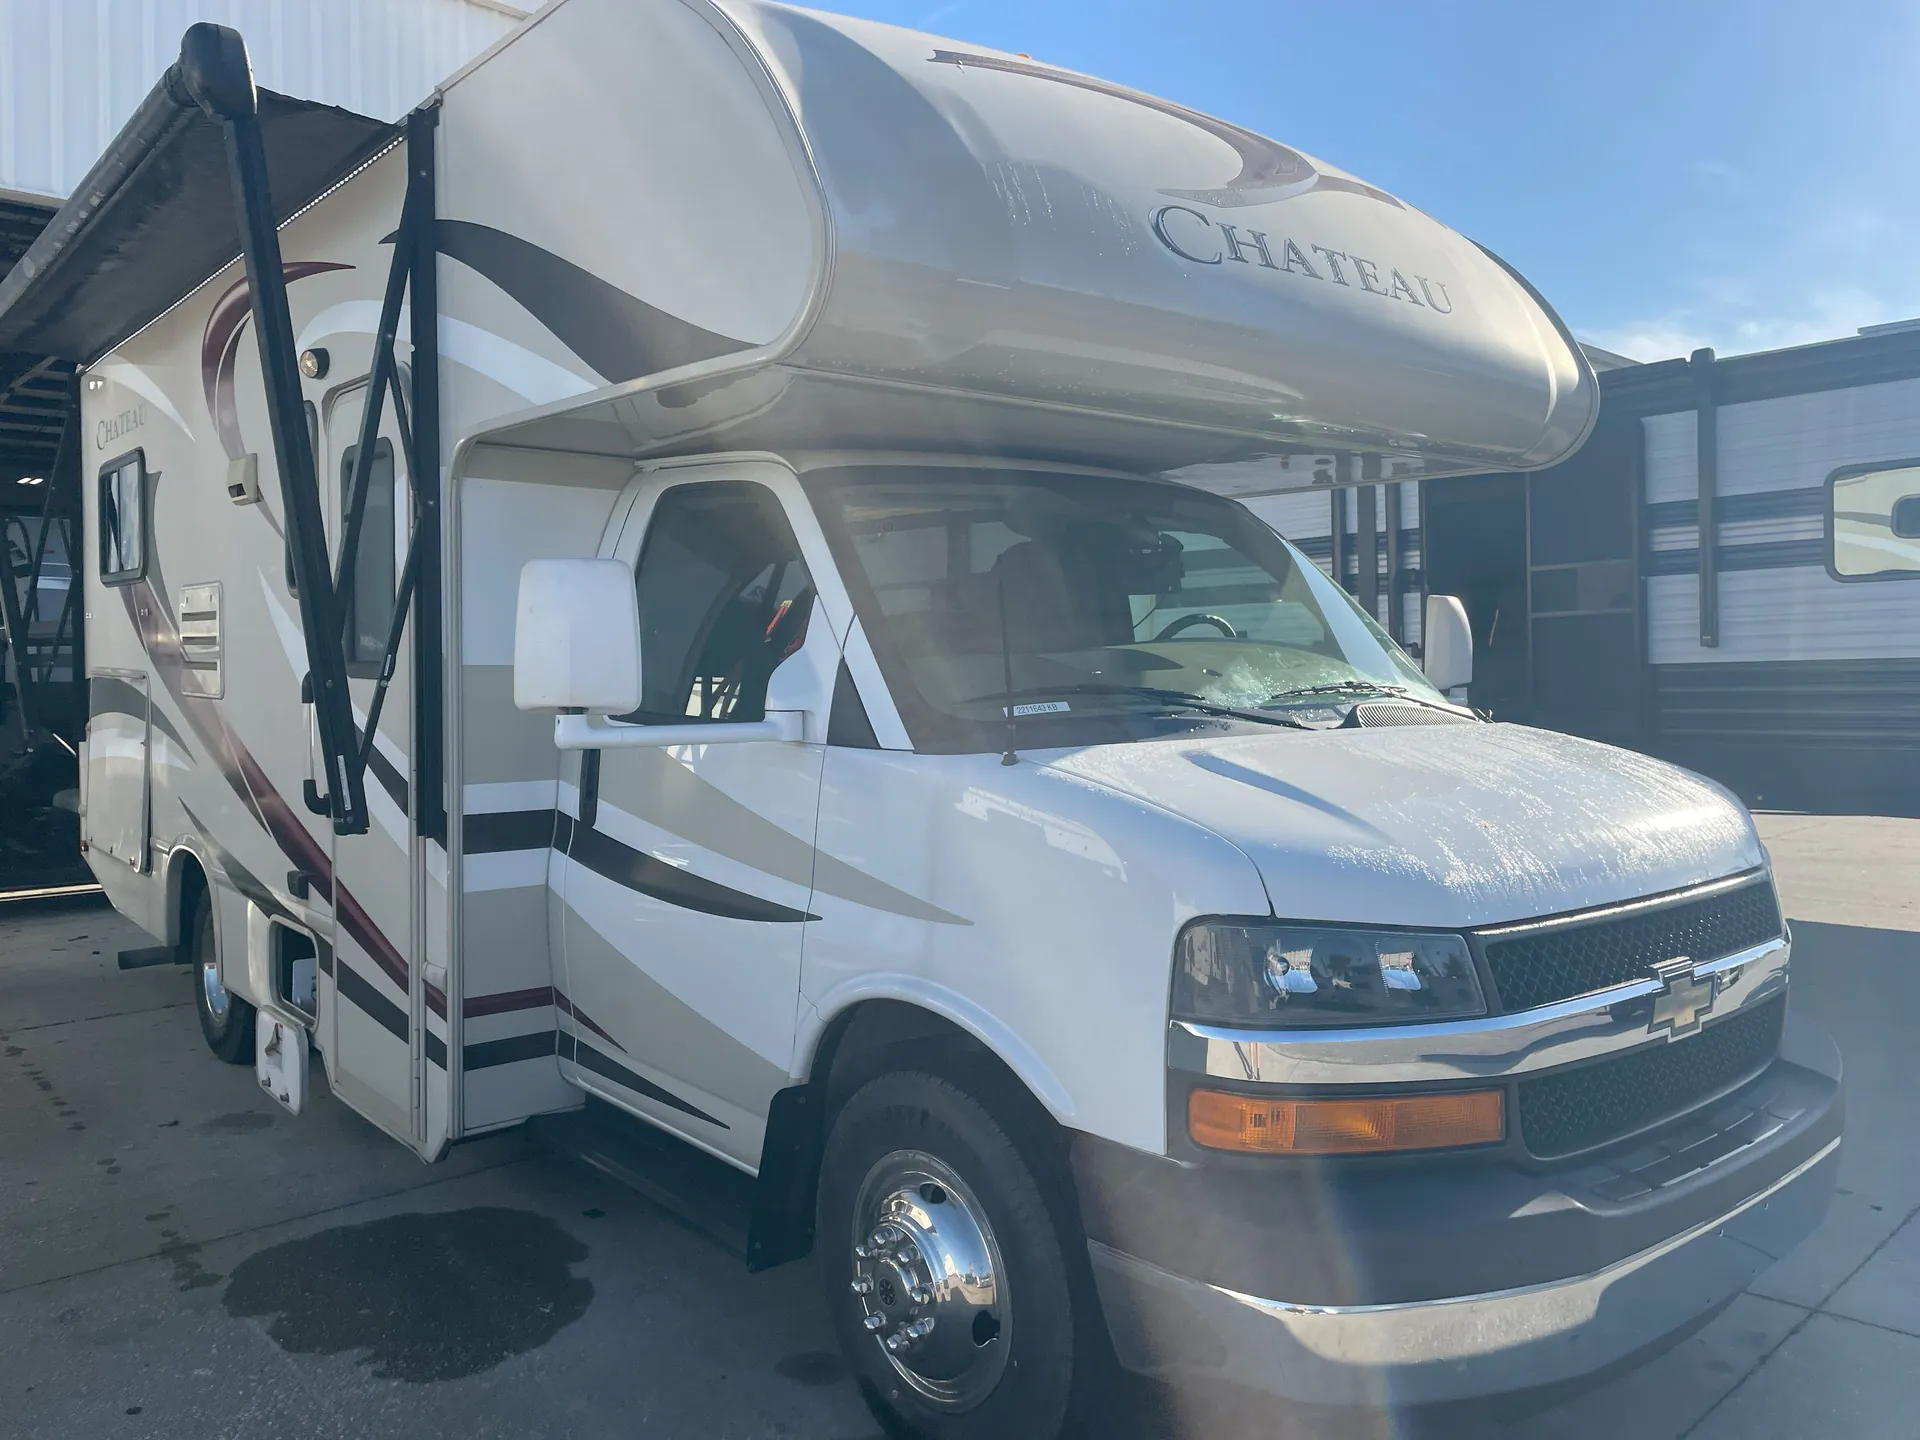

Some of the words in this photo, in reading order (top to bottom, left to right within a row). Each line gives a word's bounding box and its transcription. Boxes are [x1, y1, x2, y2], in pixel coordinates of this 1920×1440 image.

[1149, 205, 1452, 314] CHATEAU
[97, 402, 146, 450] CHATEAU
[1016, 705, 1046, 714] 2211643
[1047, 703, 1058, 711] KB
